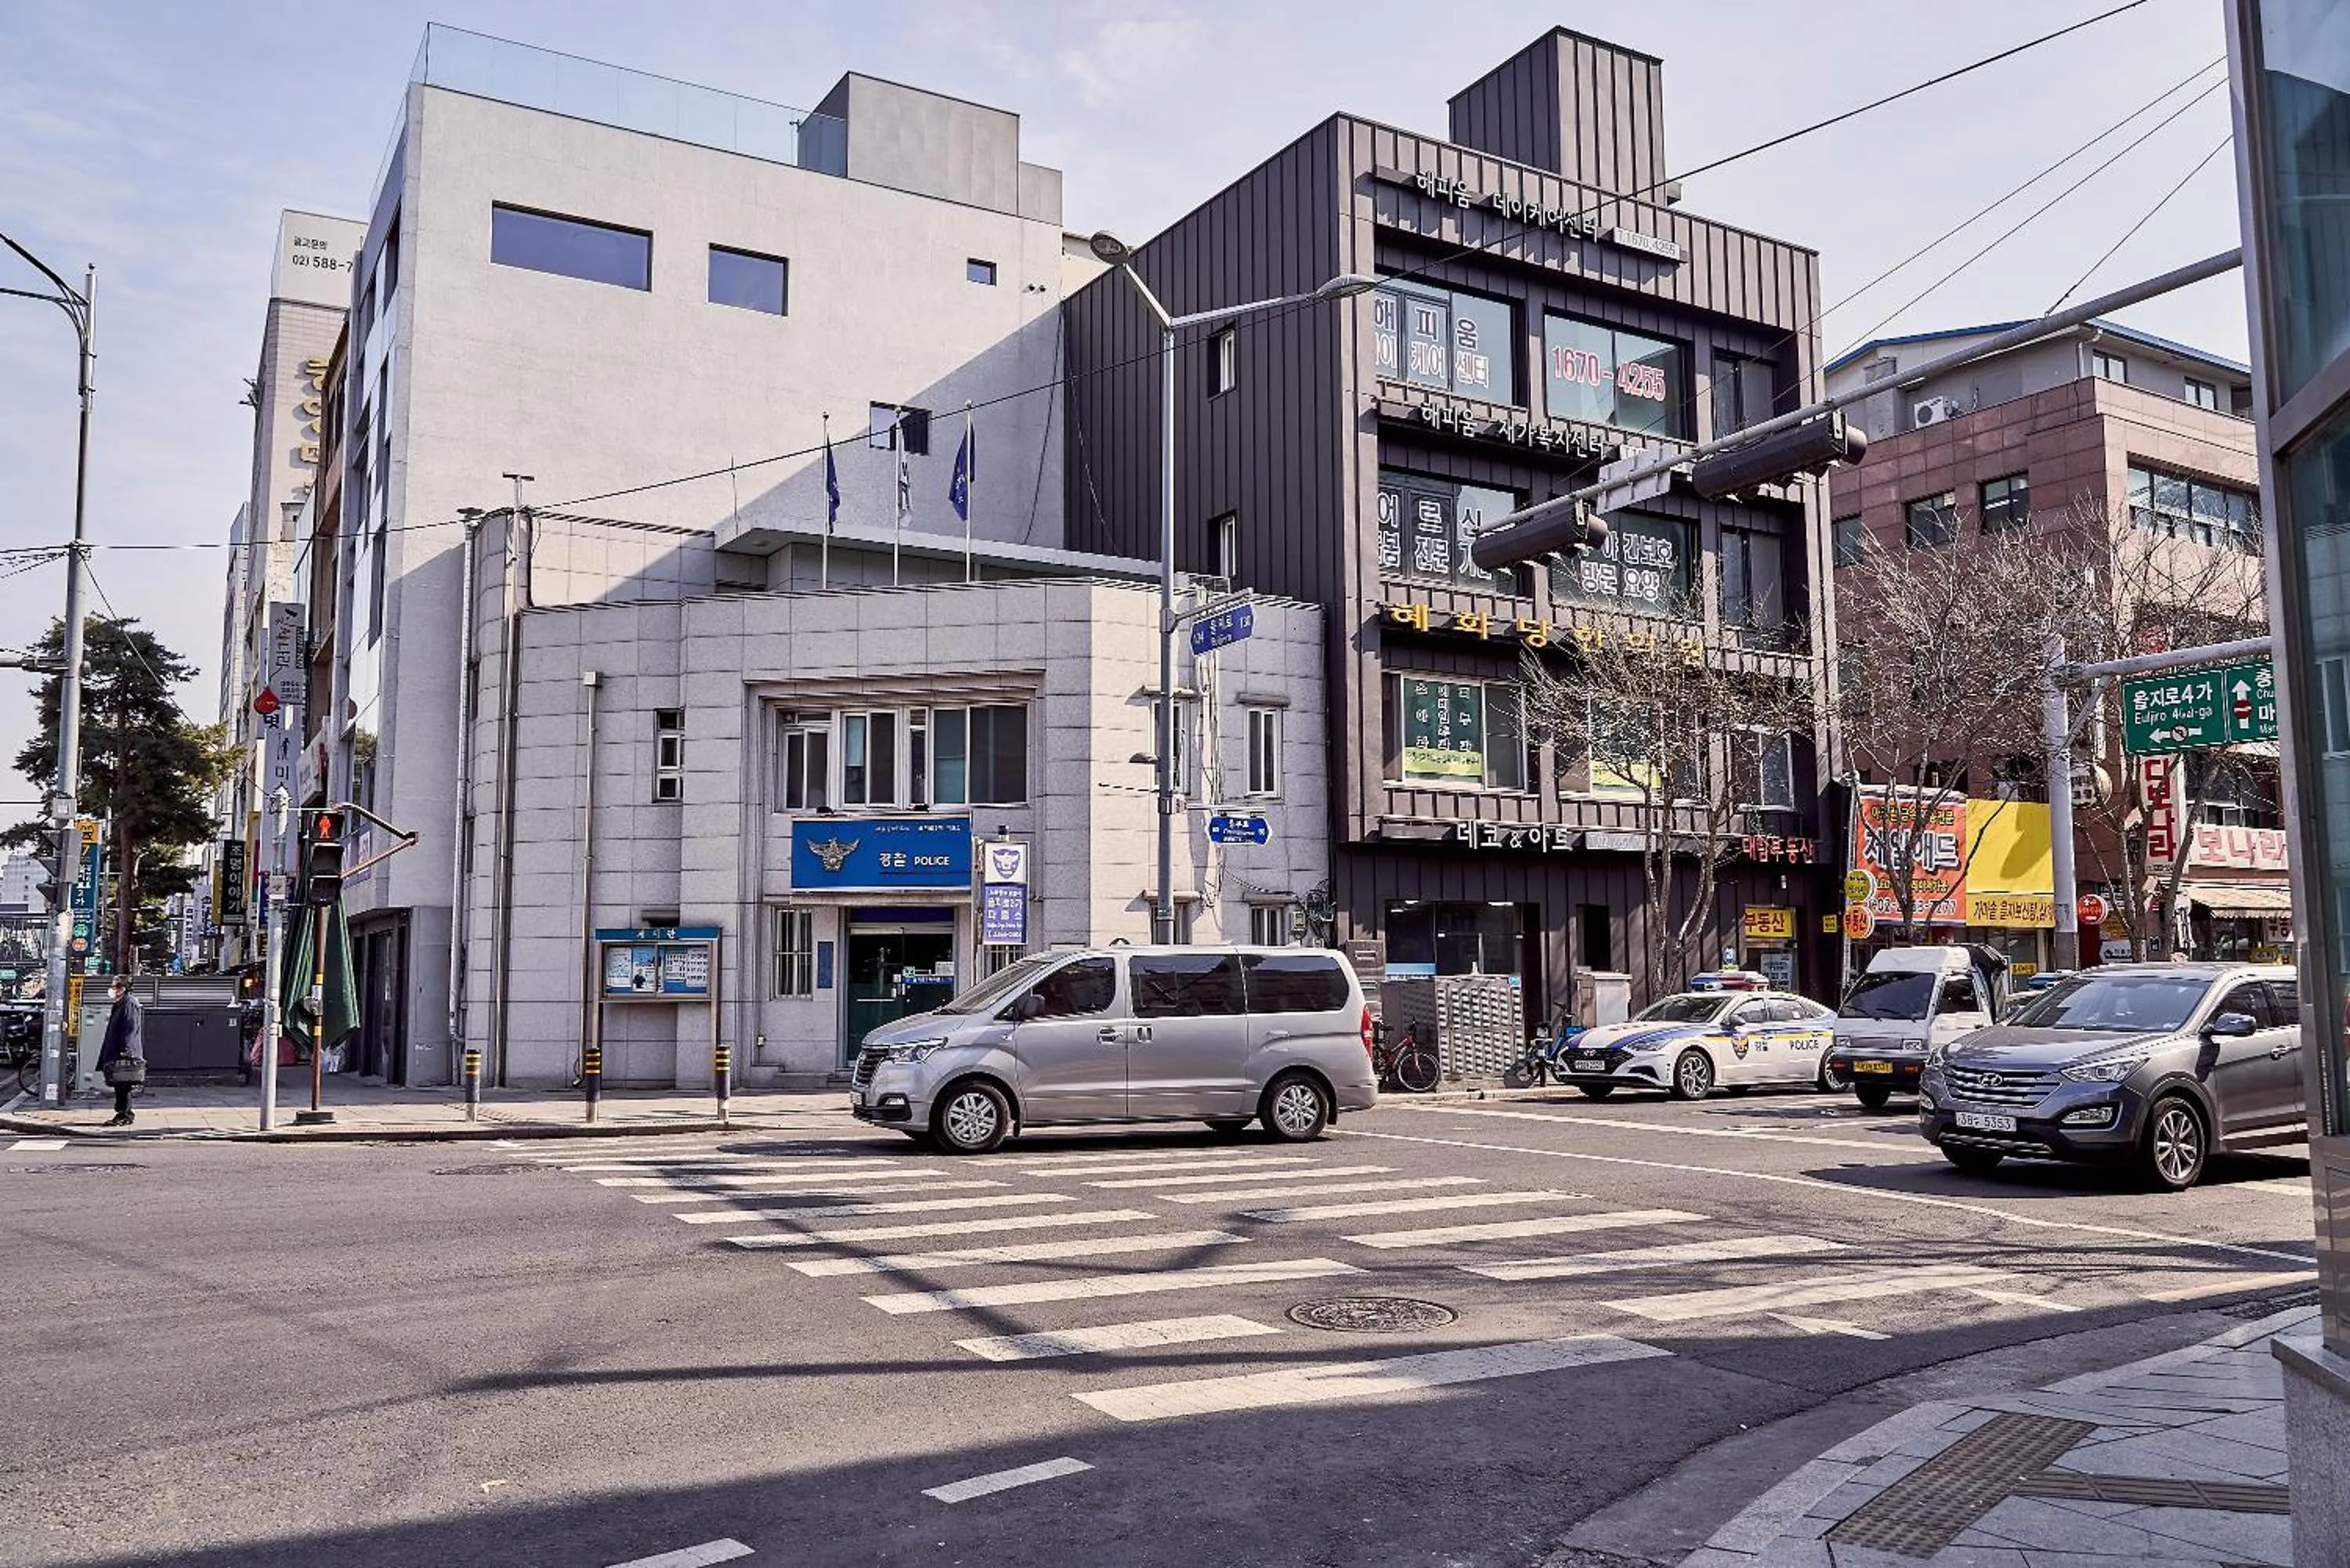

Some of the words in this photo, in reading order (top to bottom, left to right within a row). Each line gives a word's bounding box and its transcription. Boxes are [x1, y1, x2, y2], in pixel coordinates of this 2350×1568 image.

[1415, 170, 1472, 209] 해피움
[1492, 191, 1598, 243] 데이케어센터
[292, 255, 310, 266] 02)
[1421, 402, 1477, 438] 해피움
[1584, 530, 1673, 570] 야간보호
[2133, 681, 2213, 711] 을지로4가
[879, 852, 907, 868] 경찰
[913, 855, 950, 866] POLICE
[1744, 912, 1785, 934] 부동산
[1789, 1039, 1820, 1051] POLICE
